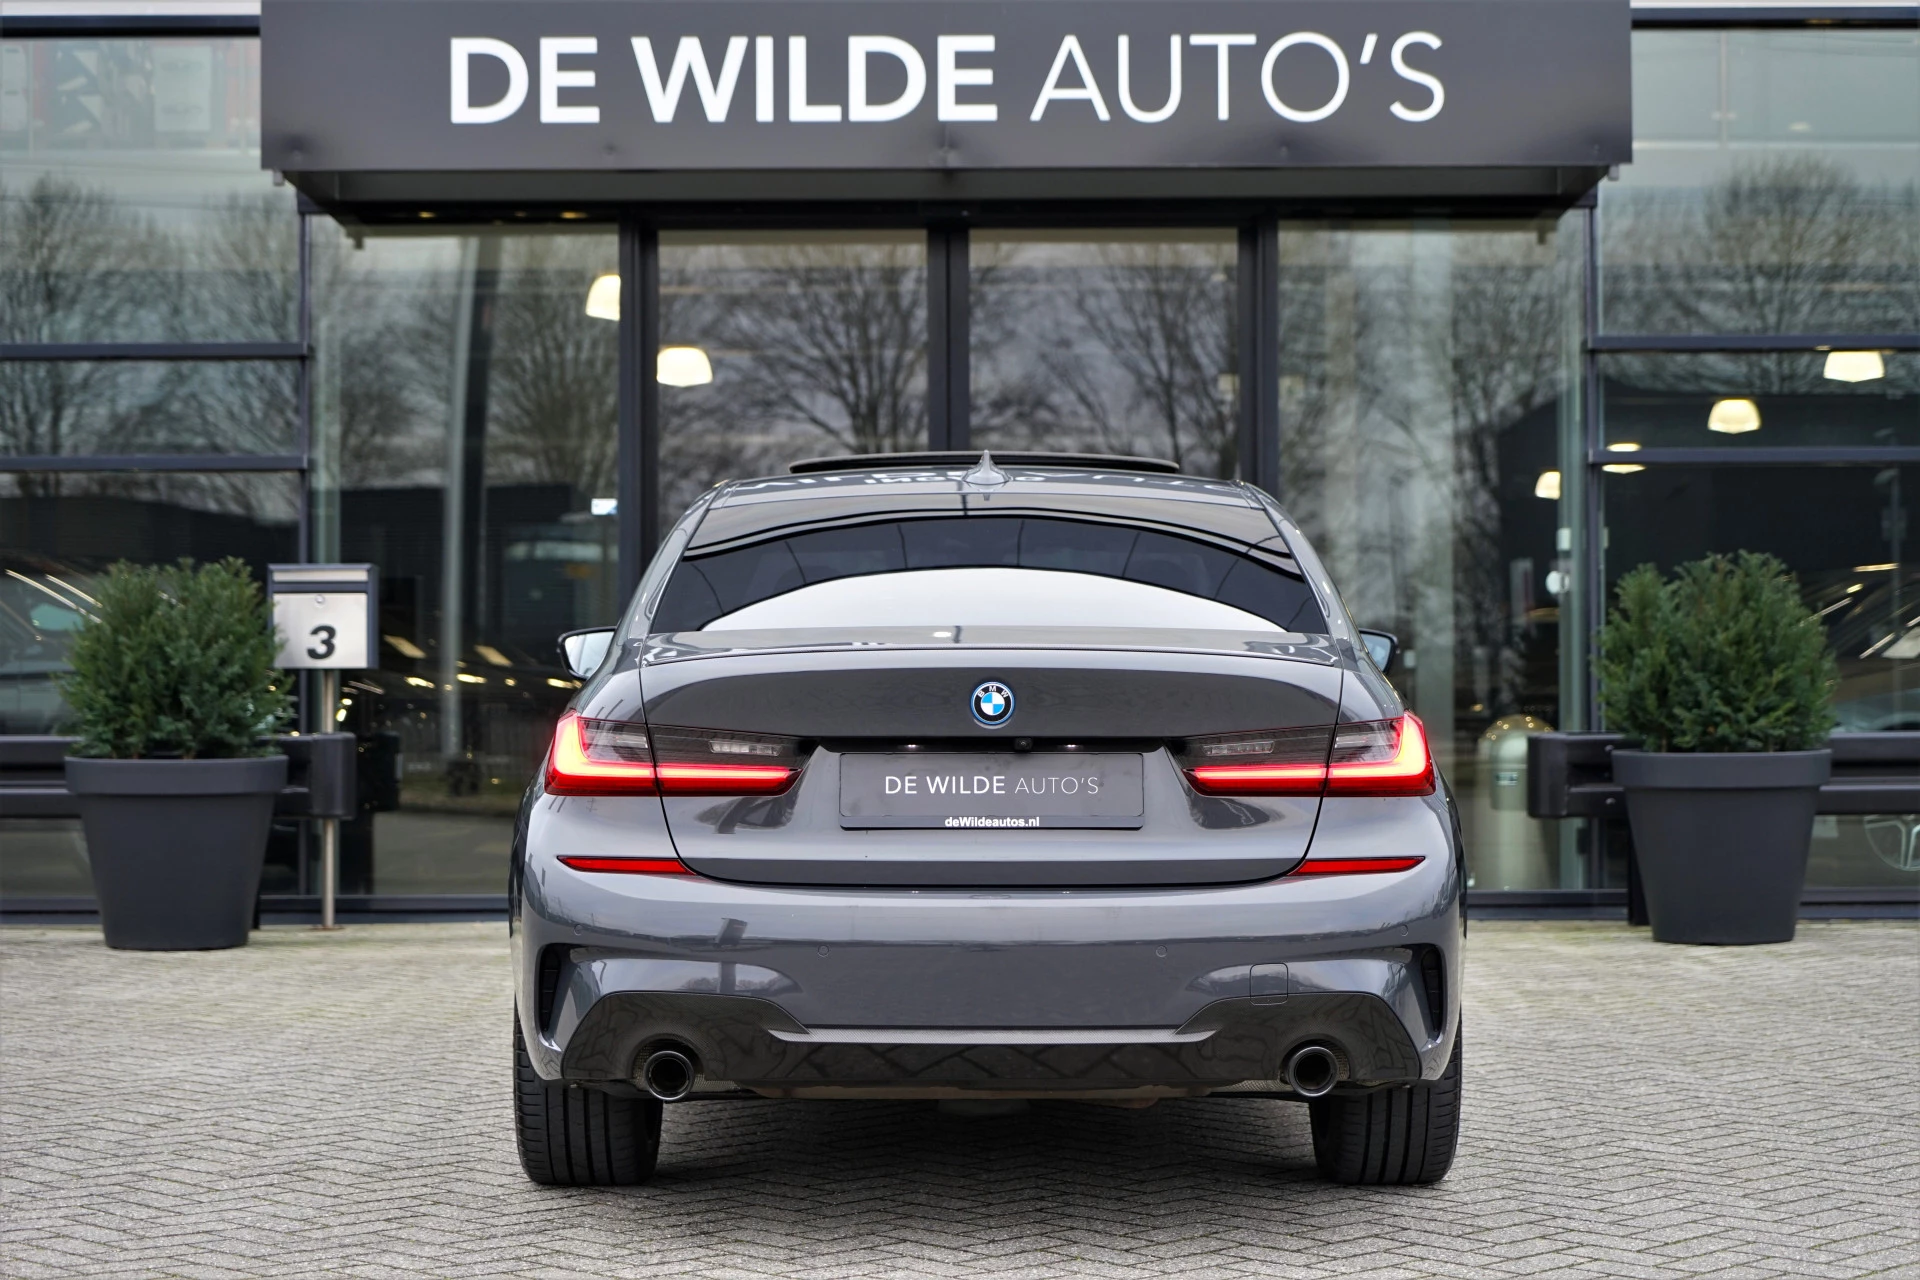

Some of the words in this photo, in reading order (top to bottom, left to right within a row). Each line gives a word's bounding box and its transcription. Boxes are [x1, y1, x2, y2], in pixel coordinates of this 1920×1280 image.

[449, 36, 601, 124] DE
[630, 35, 999, 123] WILDE
[1029, 31, 1446, 123] AUTO'S
[307, 625, 336, 660] 3
[977, 685, 1009, 698] BMW
[885, 775, 918, 794] DE
[926, 775, 1006, 794] WILDE
[1014, 776, 1099, 794] AUTO'S
[944, 816, 1040, 828] deWildeautos.nl
